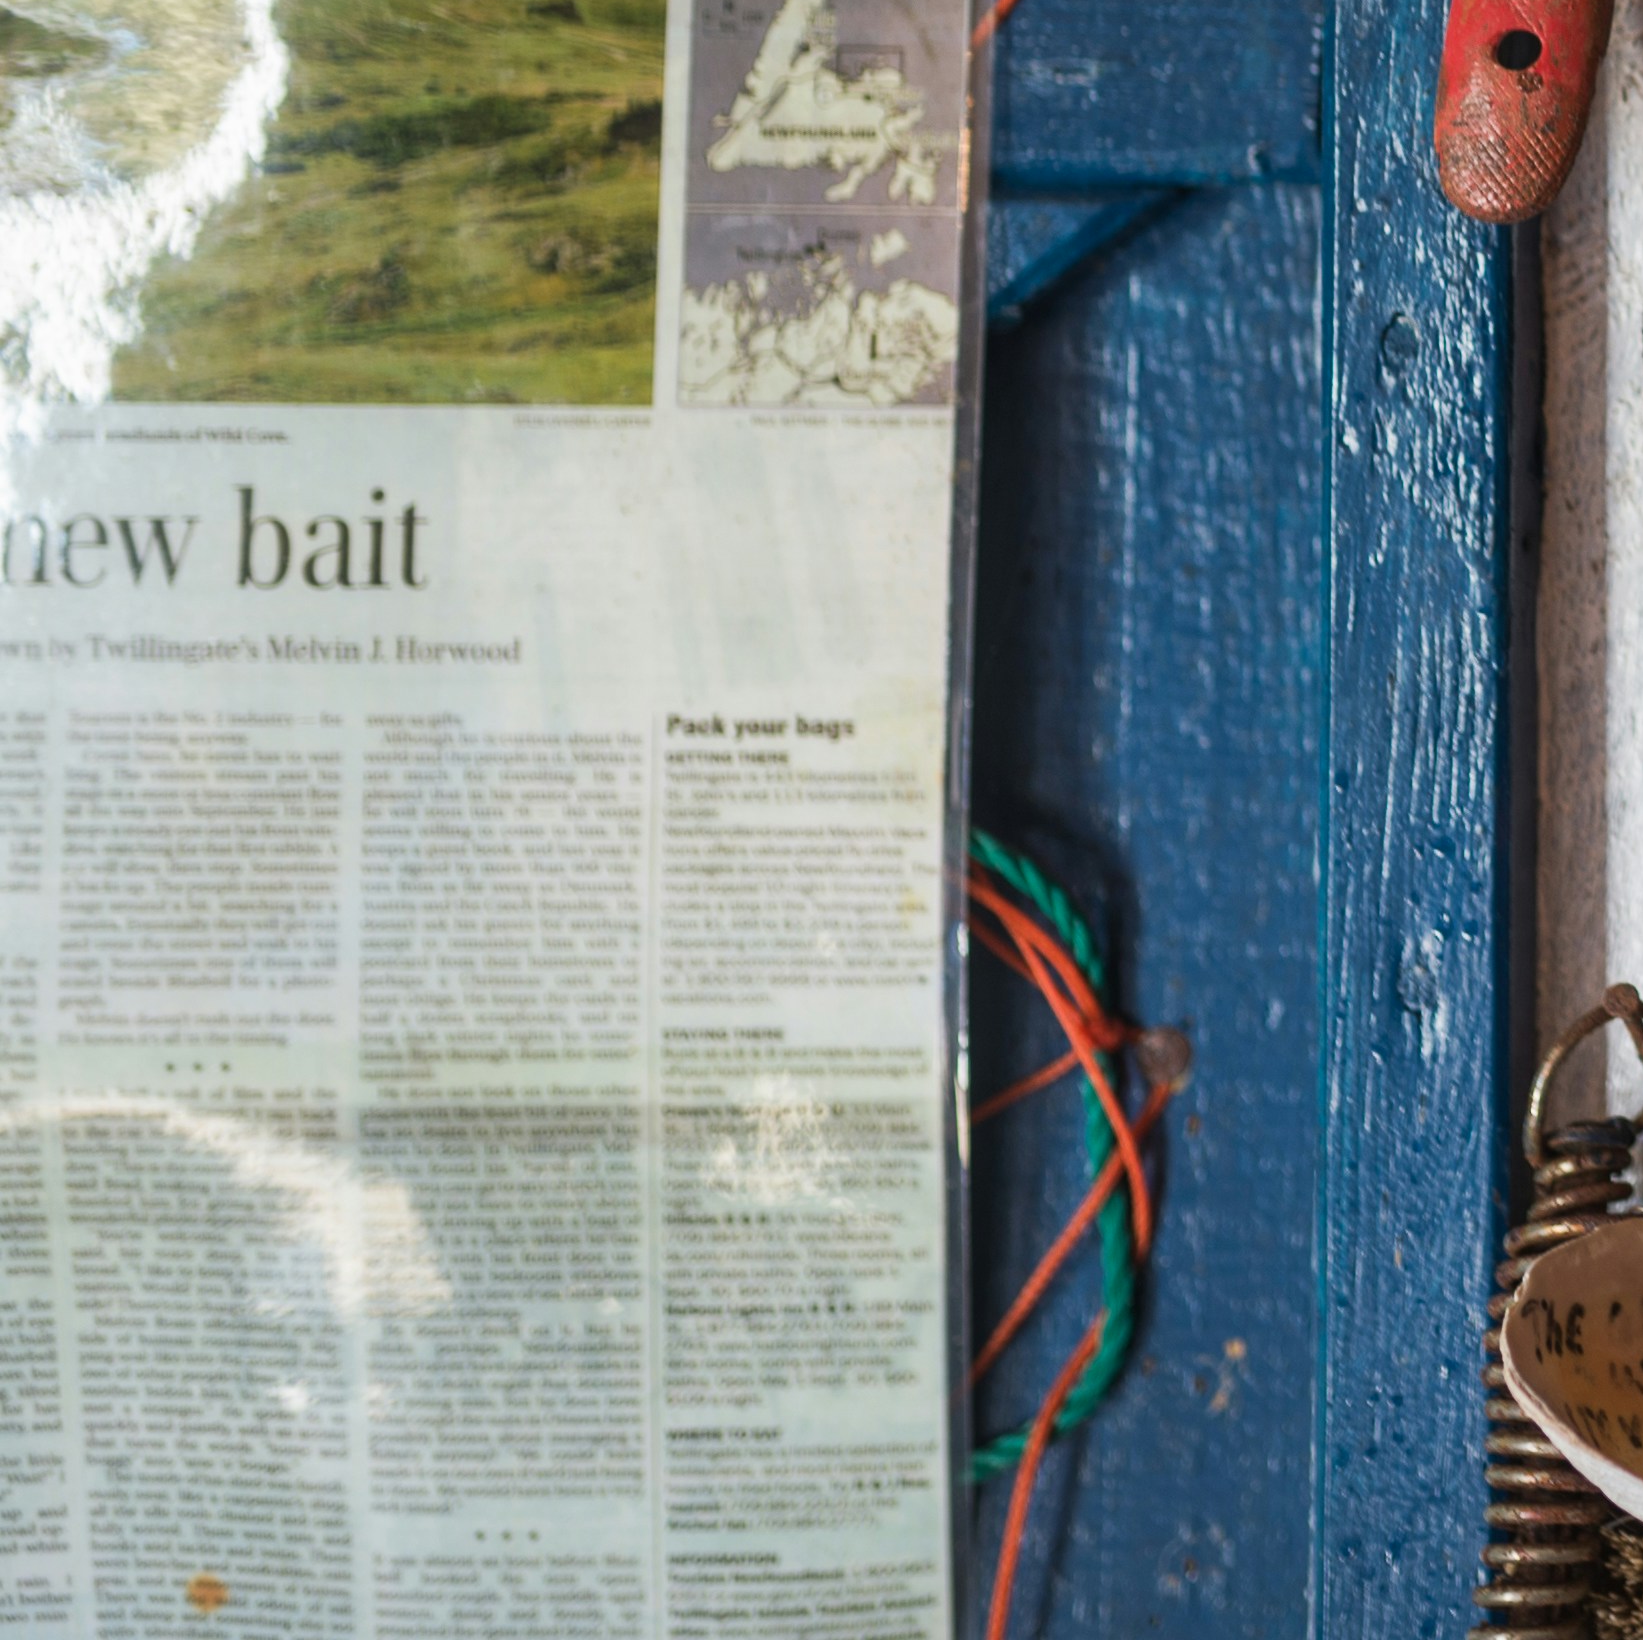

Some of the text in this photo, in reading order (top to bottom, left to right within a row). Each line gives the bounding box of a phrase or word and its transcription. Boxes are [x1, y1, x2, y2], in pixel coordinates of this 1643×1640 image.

[3, 483, 428, 590] new bait
[267, 634, 360, 662] Melvin
[396, 635, 521, 663] Horwood
[666, 713, 856, 742] Pack your bags
